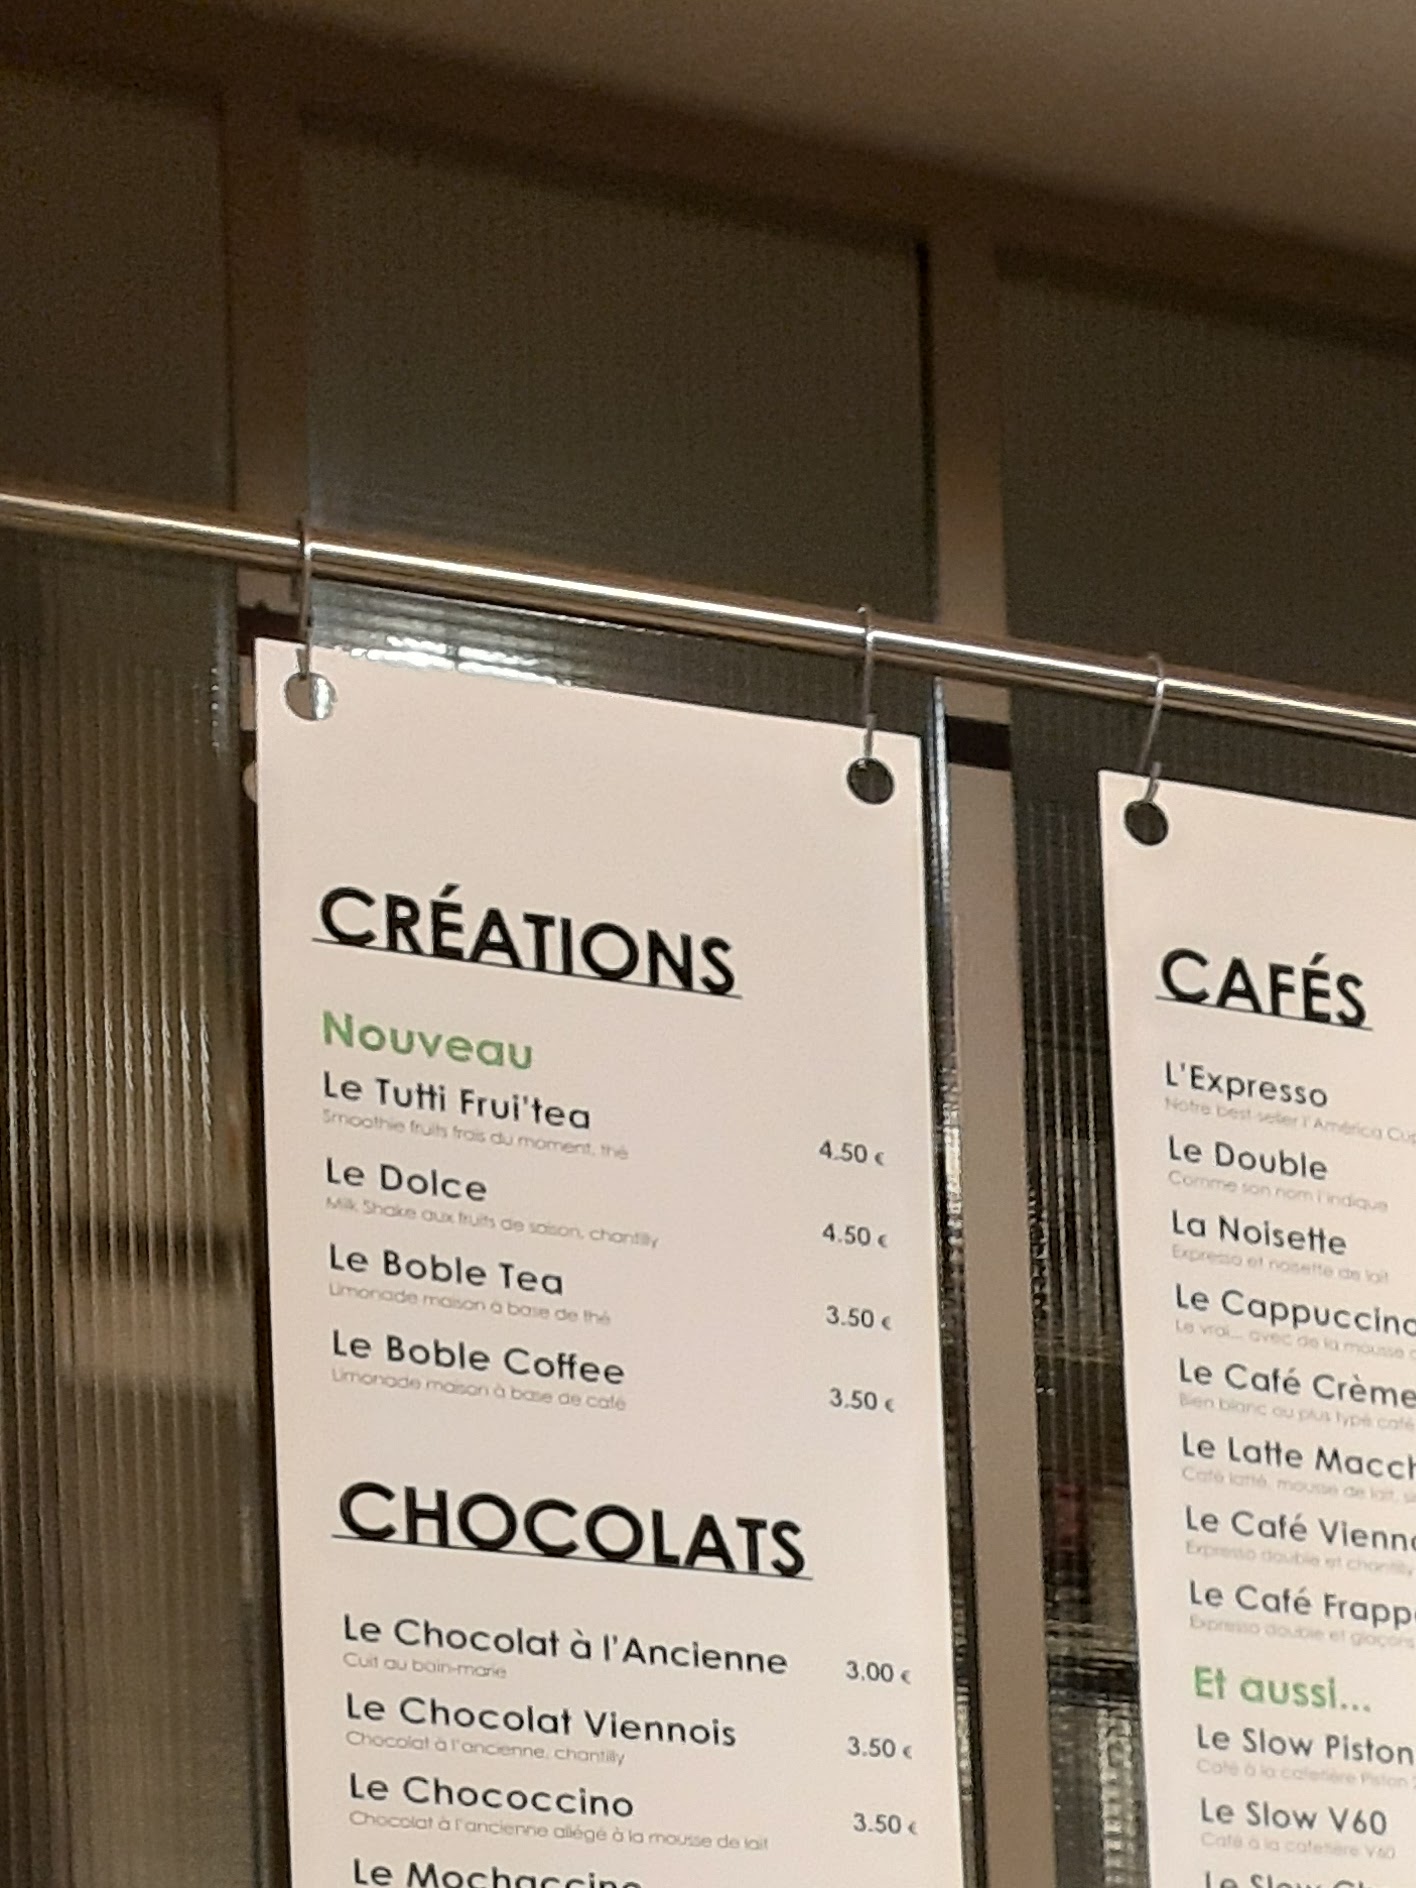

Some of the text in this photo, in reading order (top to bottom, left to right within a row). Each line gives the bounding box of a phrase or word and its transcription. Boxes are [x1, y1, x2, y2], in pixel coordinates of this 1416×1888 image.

[320, 883, 736, 996] CRÉATIONS
[1161, 947, 1367, 1029] CAFÉS
[323, 1010, 532, 1069] Nouveau
[324, 1071, 589, 1129] Le Tutti Frui'tea
[1166, 1061, 1327, 1107] L'Expresso
[819, 1140, 867, 1163] 4.50
[1169, 1135, 1327, 1180] Le Double
[326, 1157, 486, 1201] Le Dolce
[822, 1223, 870, 1246] 4.50
[1172, 1209, 1346, 1255] La Noisette
[330, 1243, 562, 1295] Le Boble Tea
[826, 1305, 874, 1328] 3.50
[1176, 1283, 1209, 1311] Le
[333, 1329, 624, 1384] Le Boble Coffee
[1180, 1357, 1212, 1385] Le
[1224, 1363, 1300, 1395] Café
[830, 1387, 877, 1410] 3.50
[1182, 1431, 1215, 1459] Le
[1228, 1436, 1302, 1468] Latte
[339, 1481, 805, 1578] CHOCOLATS
[1186, 1505, 1218, 1533] Le
[1231, 1510, 1307, 1541] Café
[344, 1614, 787, 1674] Le Chocolat à l'Ancienne
[846, 1660, 894, 1682] 3.00
[1194, 1665, 1226, 1699] Et
[347, 1693, 735, 1746] Le Chocolat Viennois
[848, 1736, 896, 1758] 3.50
[350, 1772, 633, 1817] Le Chococcino
[853, 1812, 901, 1834] 3.50
[1201, 1797, 1386, 1835] Le Slow V60
[354, 1858, 392, 1886] Le
